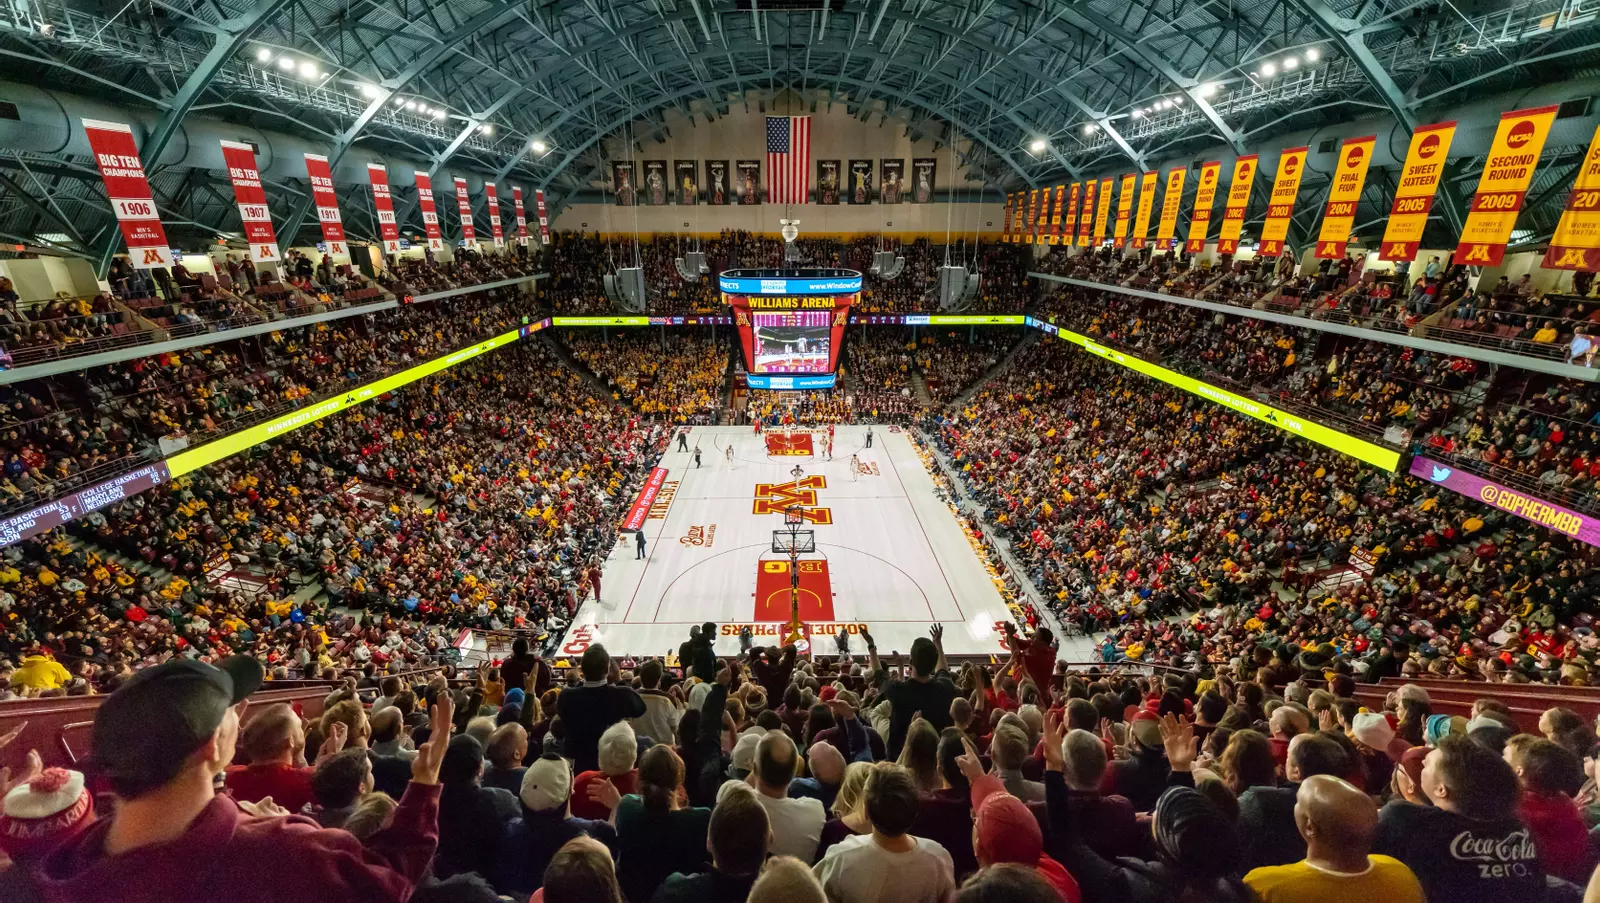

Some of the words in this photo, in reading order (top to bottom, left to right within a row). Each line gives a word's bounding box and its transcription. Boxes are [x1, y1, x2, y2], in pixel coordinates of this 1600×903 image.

[98, 154, 118, 167] BIG
[118, 155, 141, 168] TEN
[1490, 154, 1535, 168] SECOND
[102, 168, 145, 178] CHAMPIONS
[229, 167, 244, 178] BIG
[243, 168, 259, 180] TEN
[1408, 163, 1438, 175] SWEET
[1488, 167, 1527, 181] ROUND
[321, 177, 333, 186] TEN
[1340, 173, 1359, 182] FINAL
[1402, 175, 1437, 187] SIXTEEN
[1274, 188, 1296, 196] SIXTEEN
[1338, 184, 1357, 192] FOUR
[1397, 198, 1425, 211] 2005
[1478, 194, 1517, 209] 2009
[1573, 192, 1599, 207] 20
[120, 202, 151, 215] 1906
[244, 207, 265, 218] 1907
[321, 210, 336, 219] 1911
[1271, 207, 1289, 216] 2003
[1329, 203, 1352, 214] 2004
[748, 297, 799, 308] WILLIAMS
[801, 297, 836, 308] ARENA
[1198, 385, 1231, 402] MINNESOTA
[1231, 397, 1260, 414] LOTTERY
[267, 412, 310, 434] MINNESOTA
[312, 401, 340, 420] LOTTERY
[82, 482, 115, 498] COLLEGE
[114, 466, 156, 486] BASKETBALL
[84, 485, 124, 504] MARYLAND
[87, 491, 125, 510] NEBRASKA
[10, 501, 62, 526] BASKETBALL
[1480, 485, 1583, 536] @GOPHERMBB
[3, 519, 36, 537] ISLAND
[810, 624, 868, 635] GOLDE
[1450, 828, 1536, 861] Coca-Cola
[1478, 863, 1533, 878] zero.
